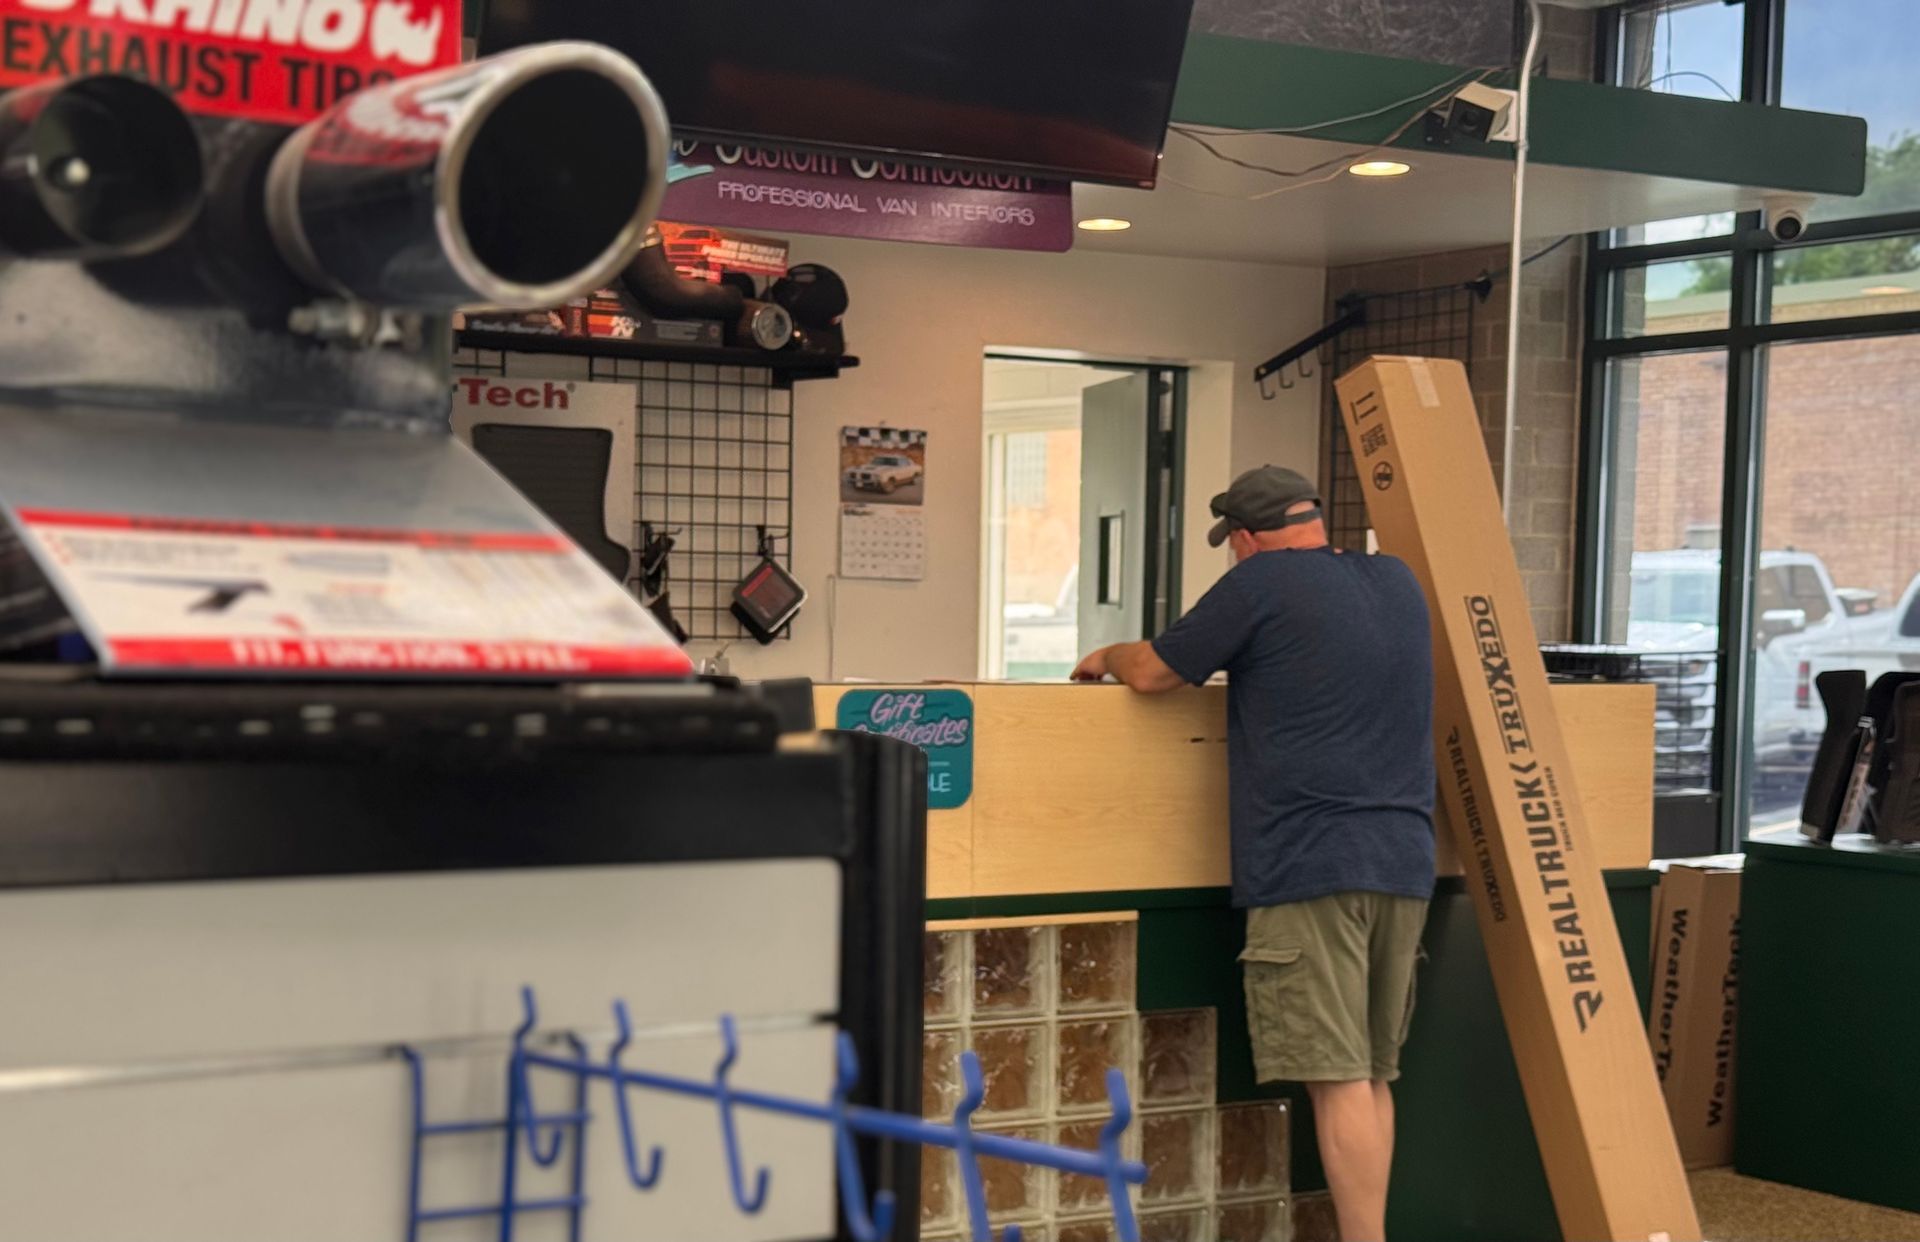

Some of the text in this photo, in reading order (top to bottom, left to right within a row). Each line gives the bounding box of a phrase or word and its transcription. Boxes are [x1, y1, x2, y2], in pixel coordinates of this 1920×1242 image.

[3, 18, 261, 101] EXHAUST
[717, 180, 1035, 226] PROFESSIONAL VAN INTERIORS
[453, 377, 570, 410] Tech
[870, 693, 926, 724] Gift
[1470, 596, 1529, 754] TRUXEDO
[853, 716, 969, 746] ificates
[1513, 777, 1597, 984] REALTRUCK
[1656, 909, 1689, 1082] WeatherTe
[1706, 917, 1742, 1128] WeatherTech
